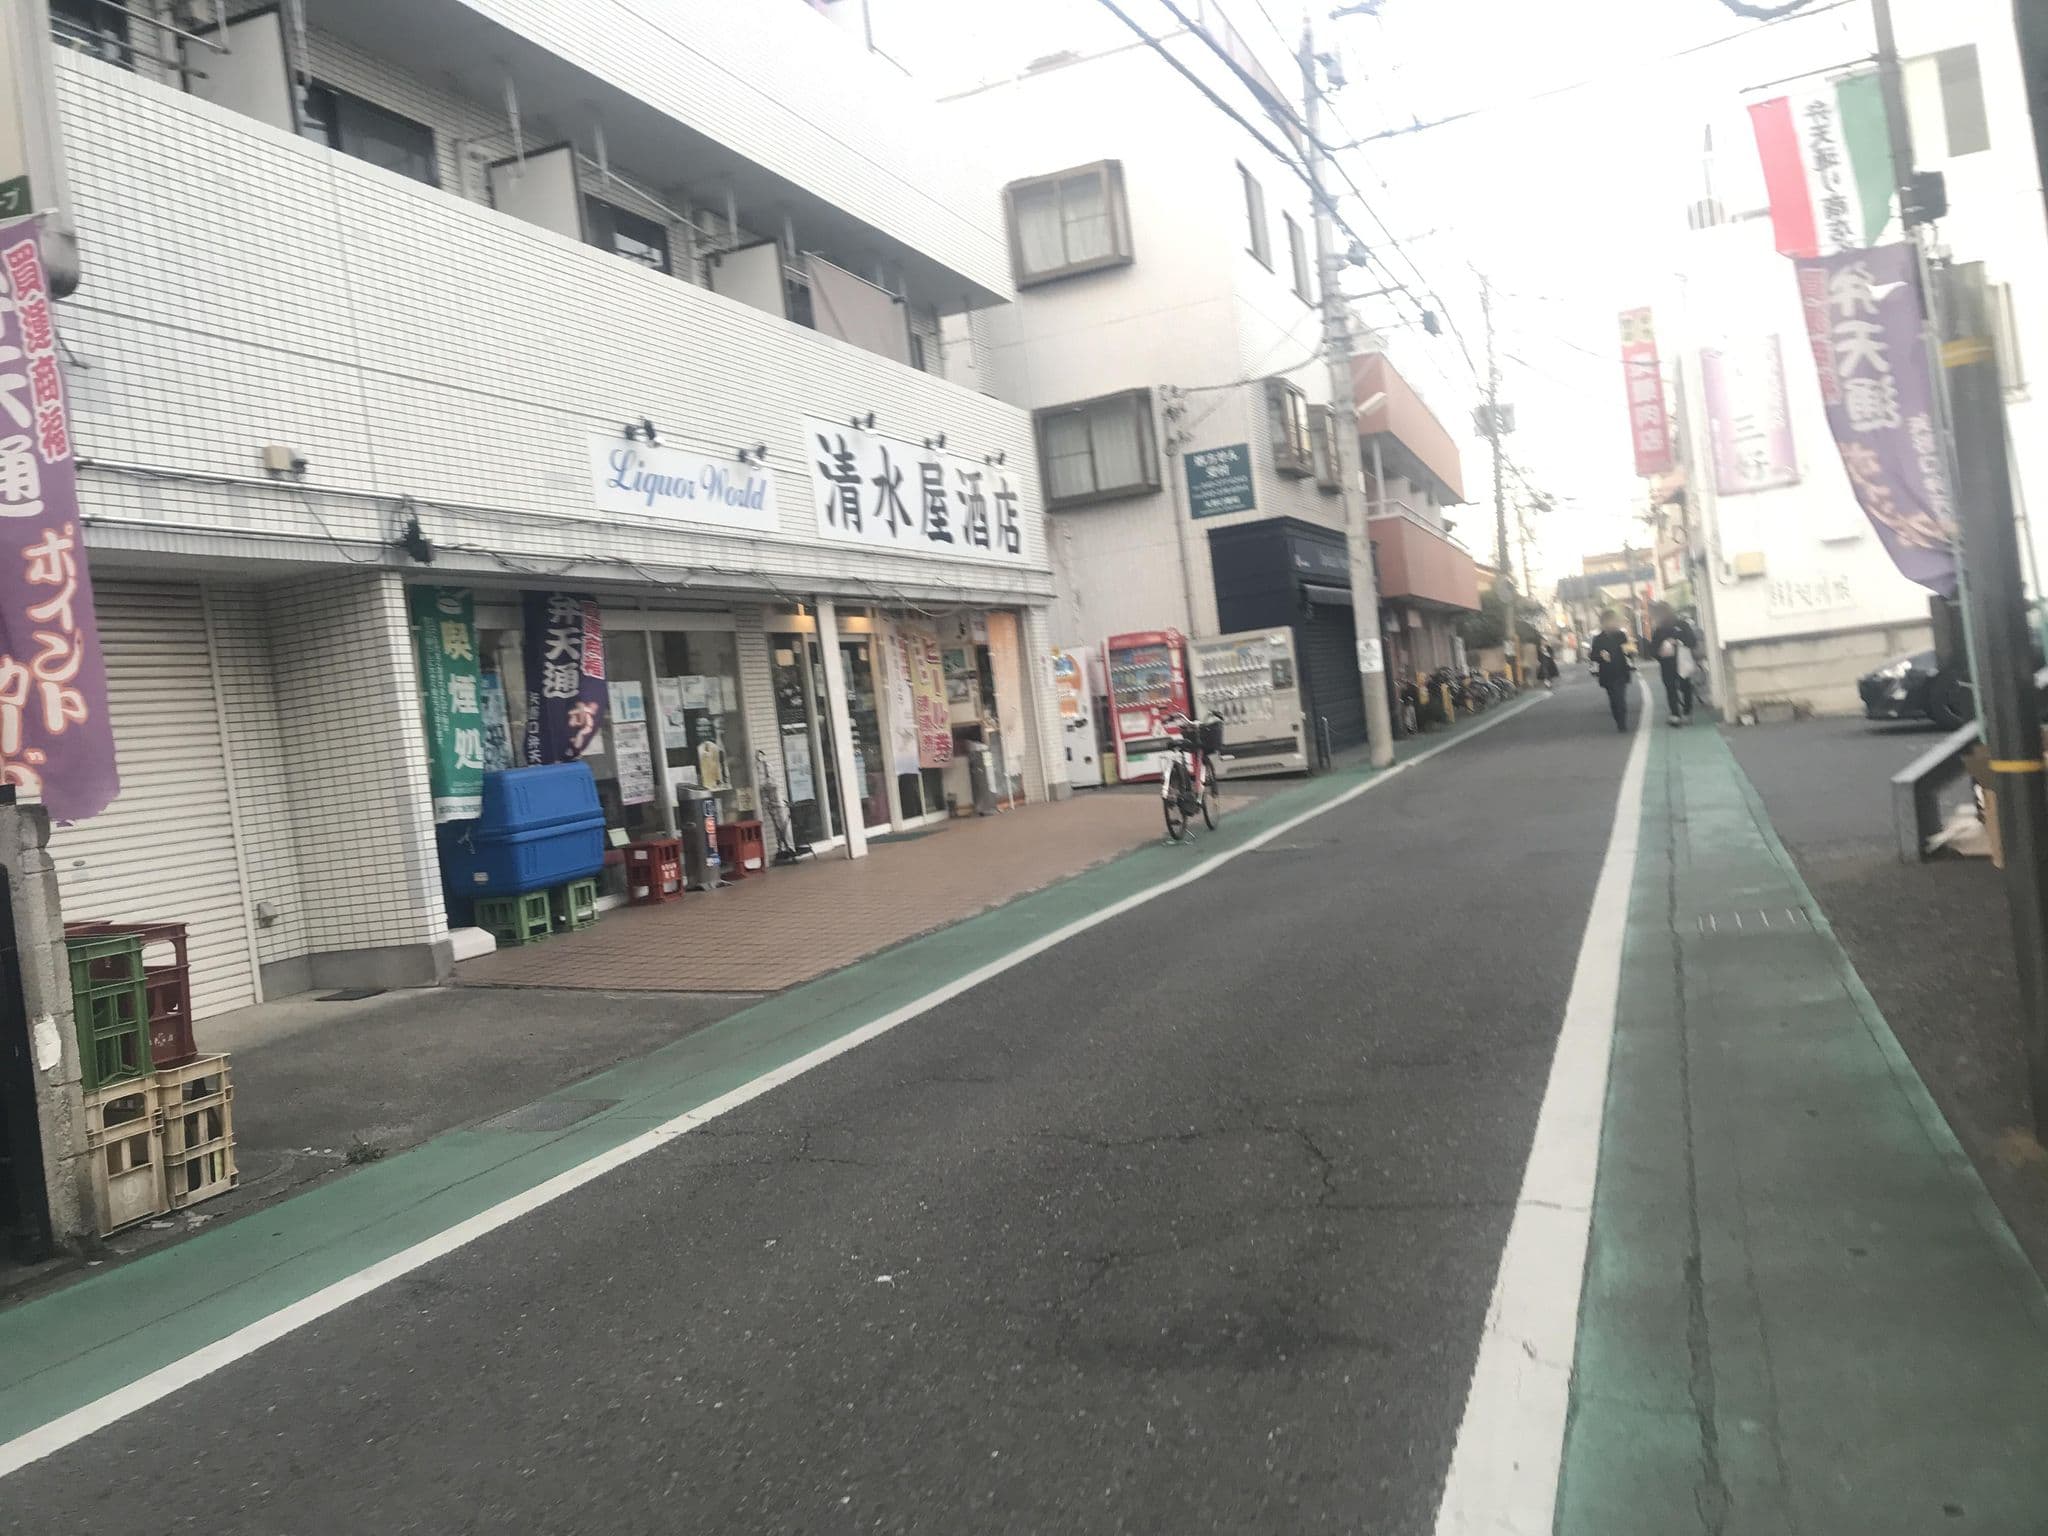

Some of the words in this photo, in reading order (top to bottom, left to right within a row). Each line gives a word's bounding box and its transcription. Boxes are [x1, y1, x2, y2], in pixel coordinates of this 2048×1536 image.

[608, 447, 696, 507] Liquor
[699, 463, 767, 511] World
[815, 432, 1022, 555] 清水屋酒店
[22, 521, 88, 734] ポイント
